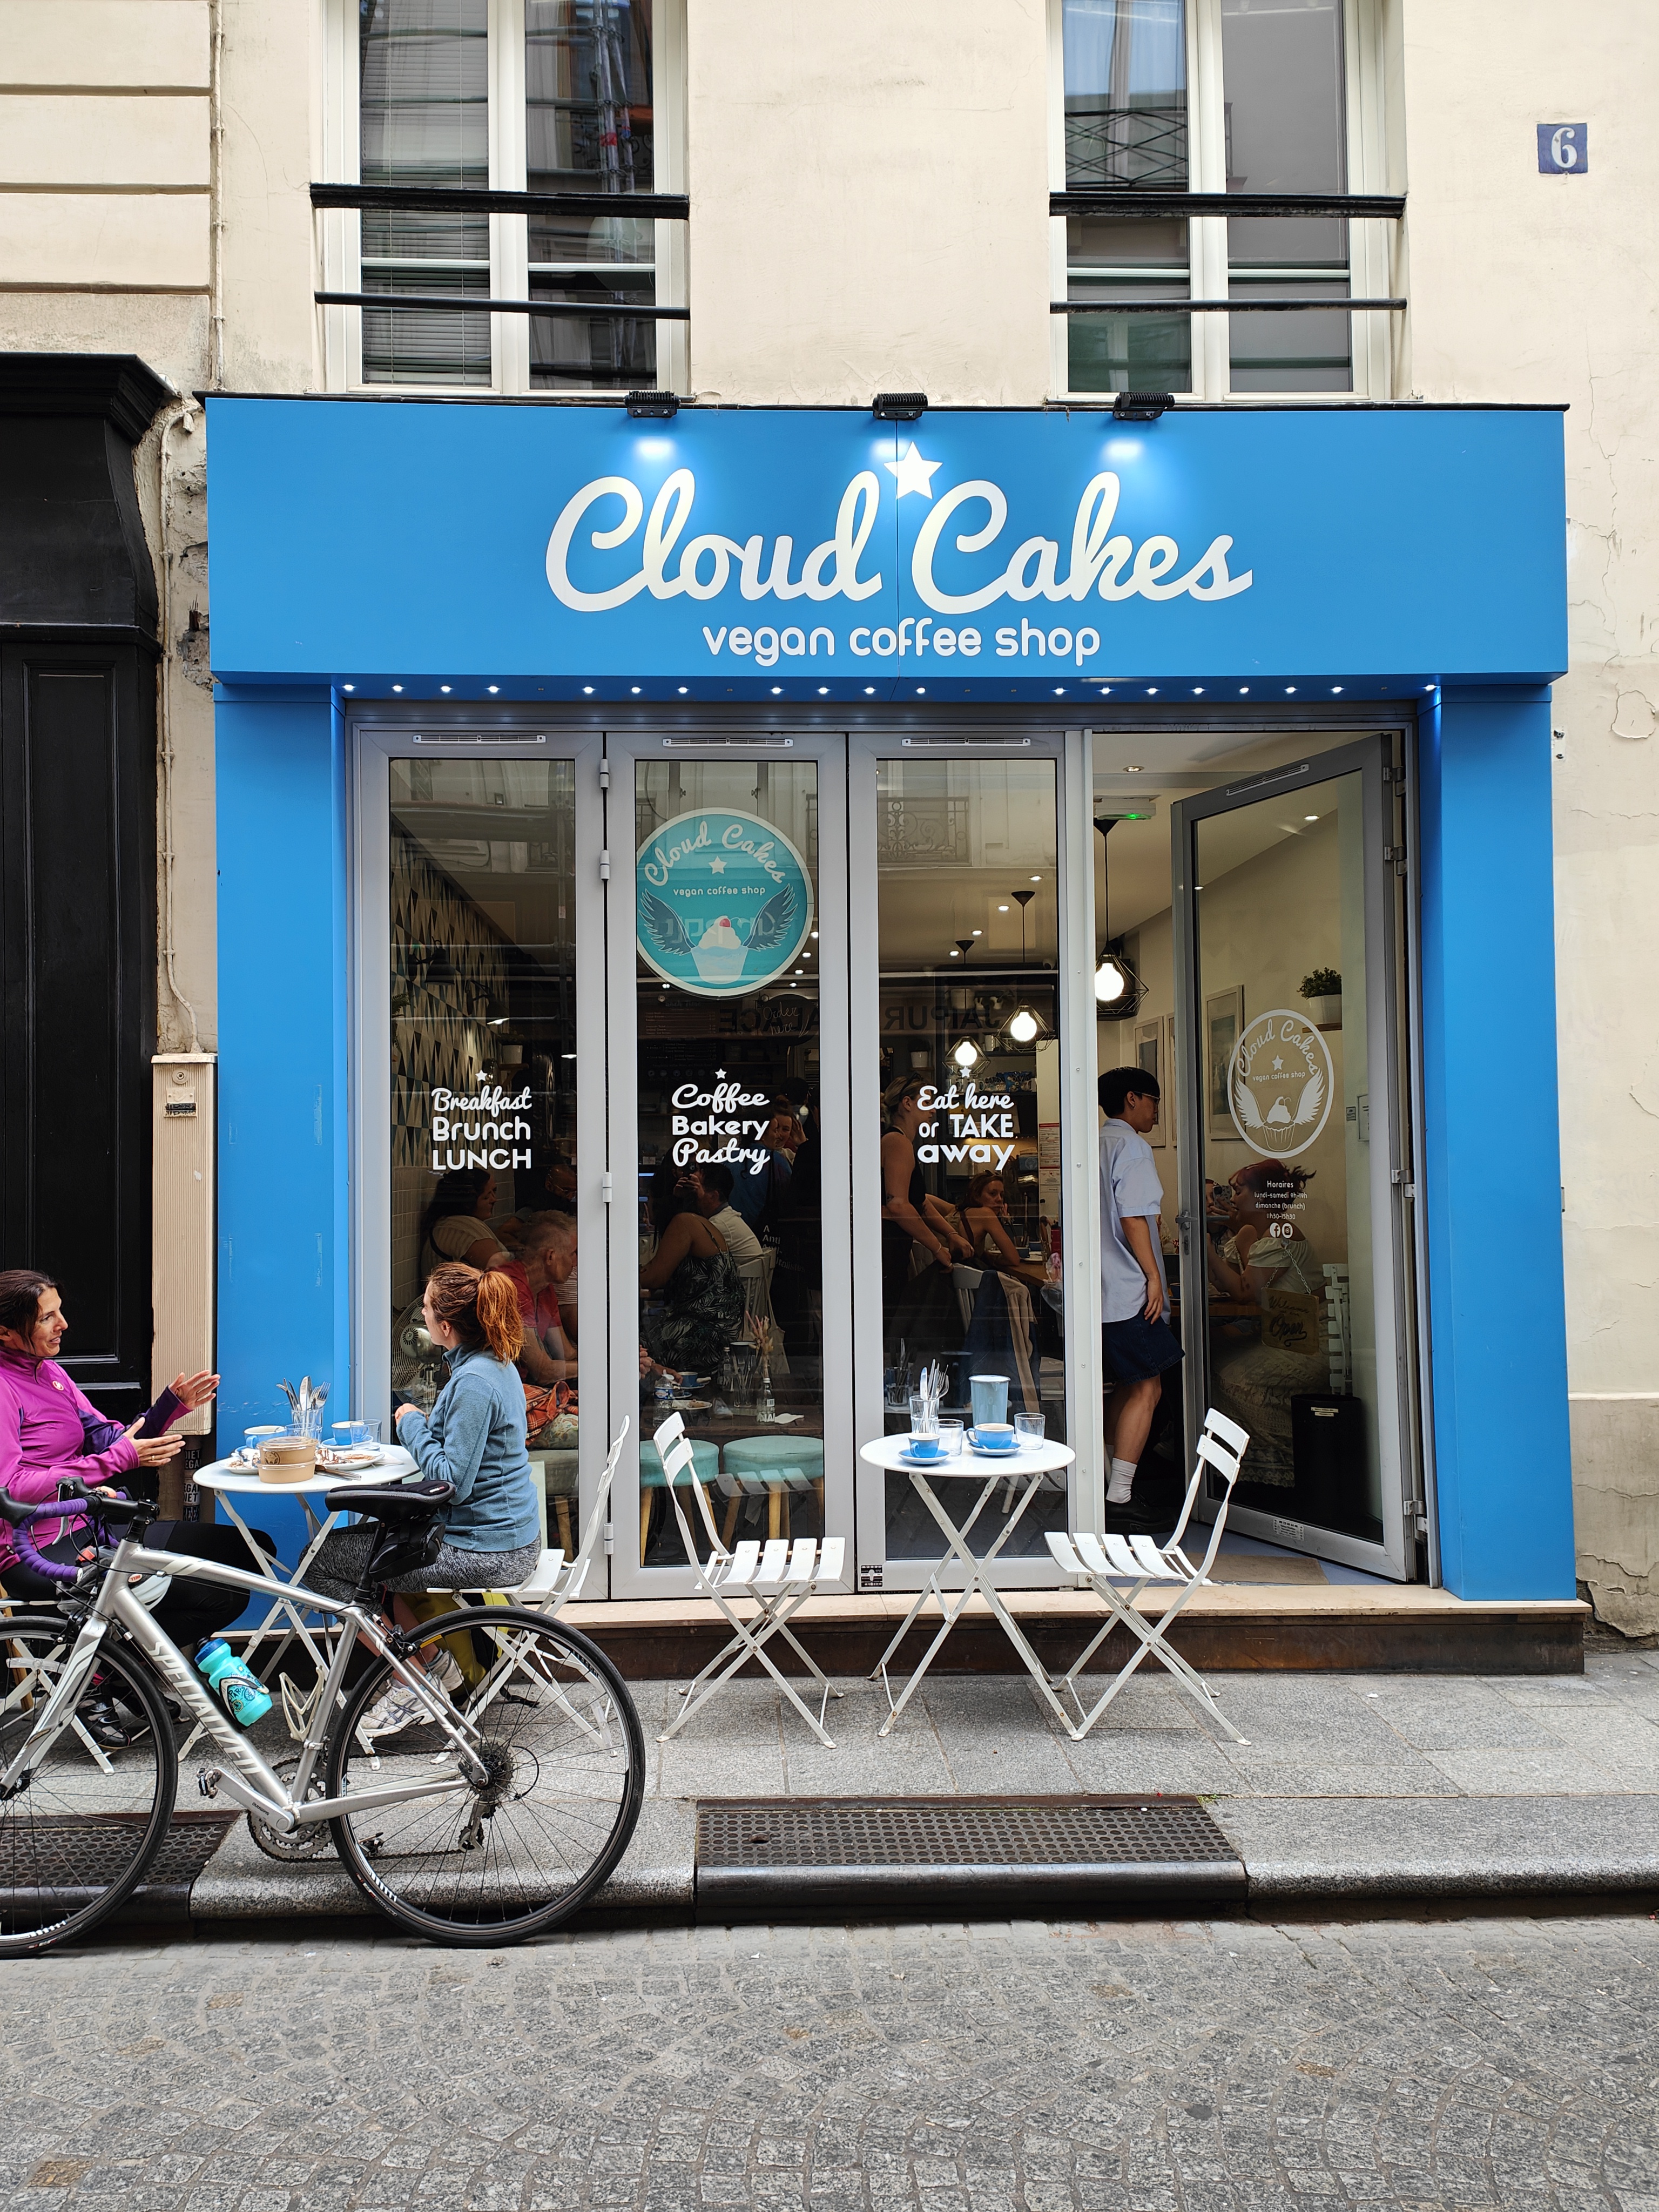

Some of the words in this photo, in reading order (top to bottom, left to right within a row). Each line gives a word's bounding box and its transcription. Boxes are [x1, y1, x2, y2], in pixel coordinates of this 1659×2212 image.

[1552, 127, 1577, 168] 6
[545, 468, 883, 612] Cloud
[912, 471, 1253, 615] Cakes
[702, 626, 835, 667] vegan
[849, 617, 982, 657] coffee
[995, 617, 1101, 667] shop
[645, 821, 712, 886] Cloud
[721, 824, 786, 884] Cakes
[673, 888, 703, 898] vegan
[707, 886, 738, 895] coffee
[741, 886, 766, 896] shop
[763, 1001, 800, 1020] Order
[770, 1022, 795, 1036] here
[1237, 1019, 1276, 1077] Cloud
[1279, 1019, 1318, 1075] Cakes
[1252, 1074, 1270, 1082] vegan
[1271, 1072, 1289, 1080] coffee
[1291, 1071, 1306, 1079] shop
[431, 1085, 532, 1117] Breakfast
[671, 1082, 770, 1114] Coffee
[917, 1084, 960, 1110] Eat
[965, 1082, 1014, 1109] here
[433, 1116, 531, 1141] Brunch
[672, 1115, 770, 1141] Bakery
[919, 1122, 939, 1138] or
[949, 1114, 1014, 1138] TAKE
[433, 1149, 531, 1170] LUNCH
[672, 1137, 771, 1175] Pastry
[917, 1144, 1015, 1170] away
[1266, 1180, 1294, 1188] Horaires
[1282, 1202, 1305, 1210] (brunch)
[142, 1641, 263, 1774] SPECIALIZED
